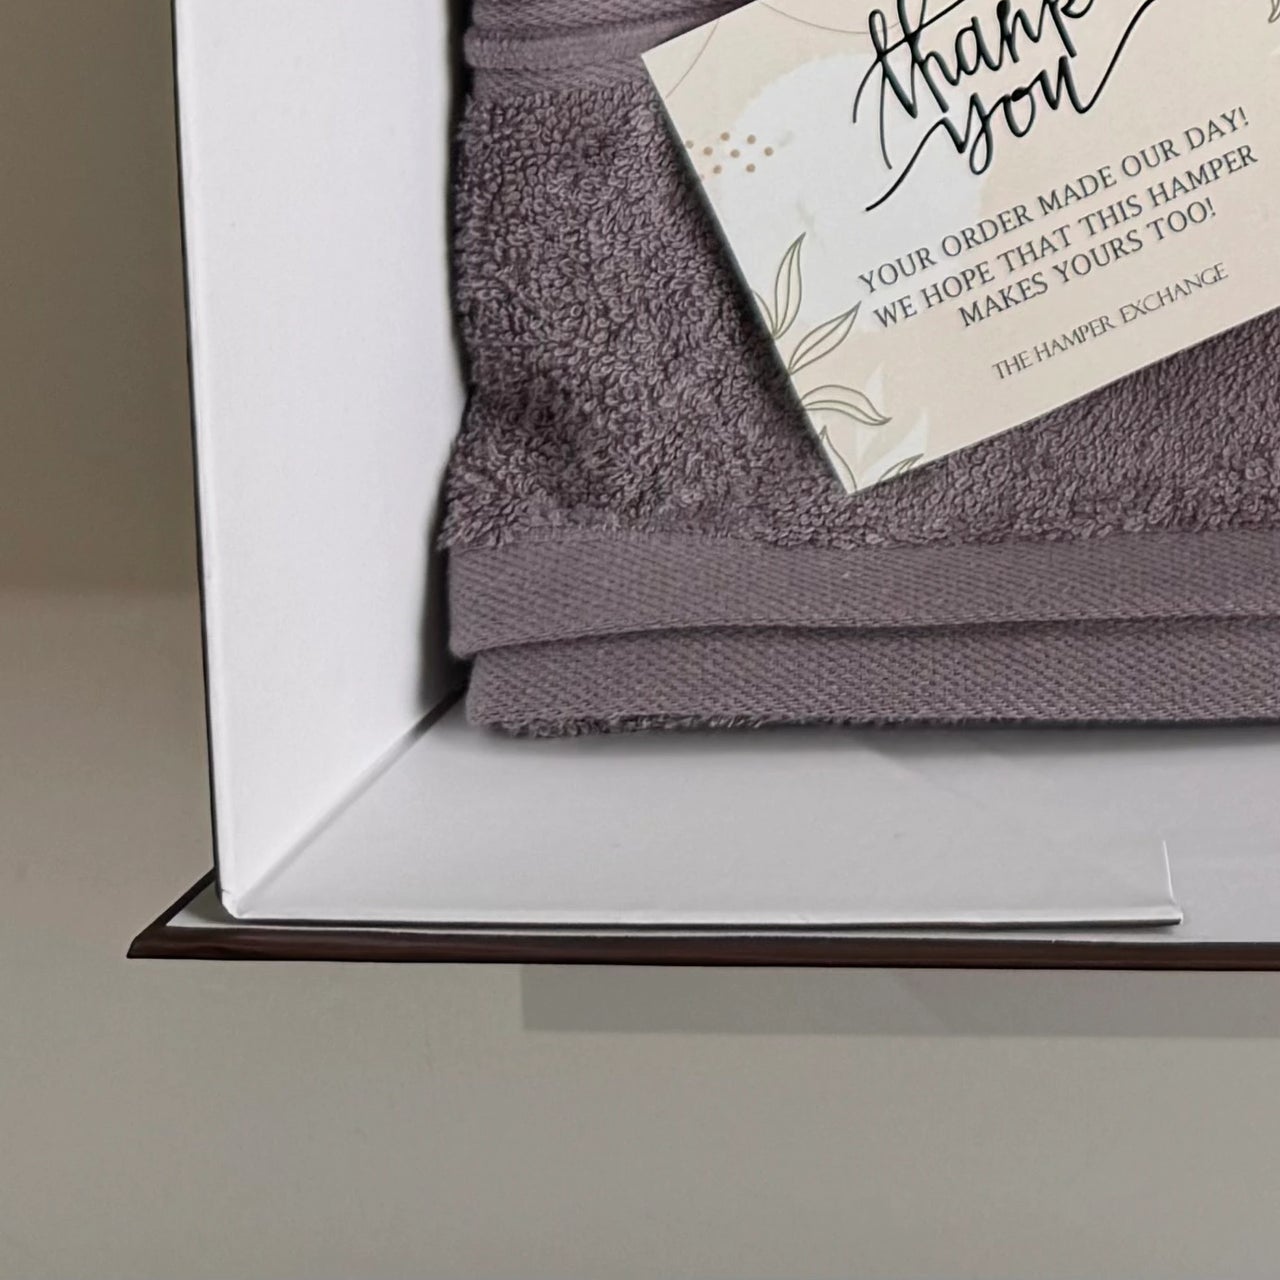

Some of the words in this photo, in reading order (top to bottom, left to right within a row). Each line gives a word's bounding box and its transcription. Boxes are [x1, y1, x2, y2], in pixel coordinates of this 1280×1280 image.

[858, 246, 937, 294] YOUR
[941, 204, 1034, 258] ORDER
[1036, 166, 1117, 217] MADE
[1121, 138, 1181, 178] OUR
[1184, 106, 1249, 151] DAY!
[873, 295, 917, 329] WE
[920, 261, 996, 309] HOPE
[996, 225, 1070, 274] THAT
[1078, 194, 1143, 237] THIS
[1146, 144, 1259, 208] HAMPER
[958, 272, 1049, 328] MAKES
[1052, 236, 1144, 284] YOURS
[1146, 197, 1217, 241] TOO!
[992, 351, 1033, 380] THE
[1033, 315, 1116, 362] HAMPER
[1119, 262, 1229, 324] EXCHANGE
